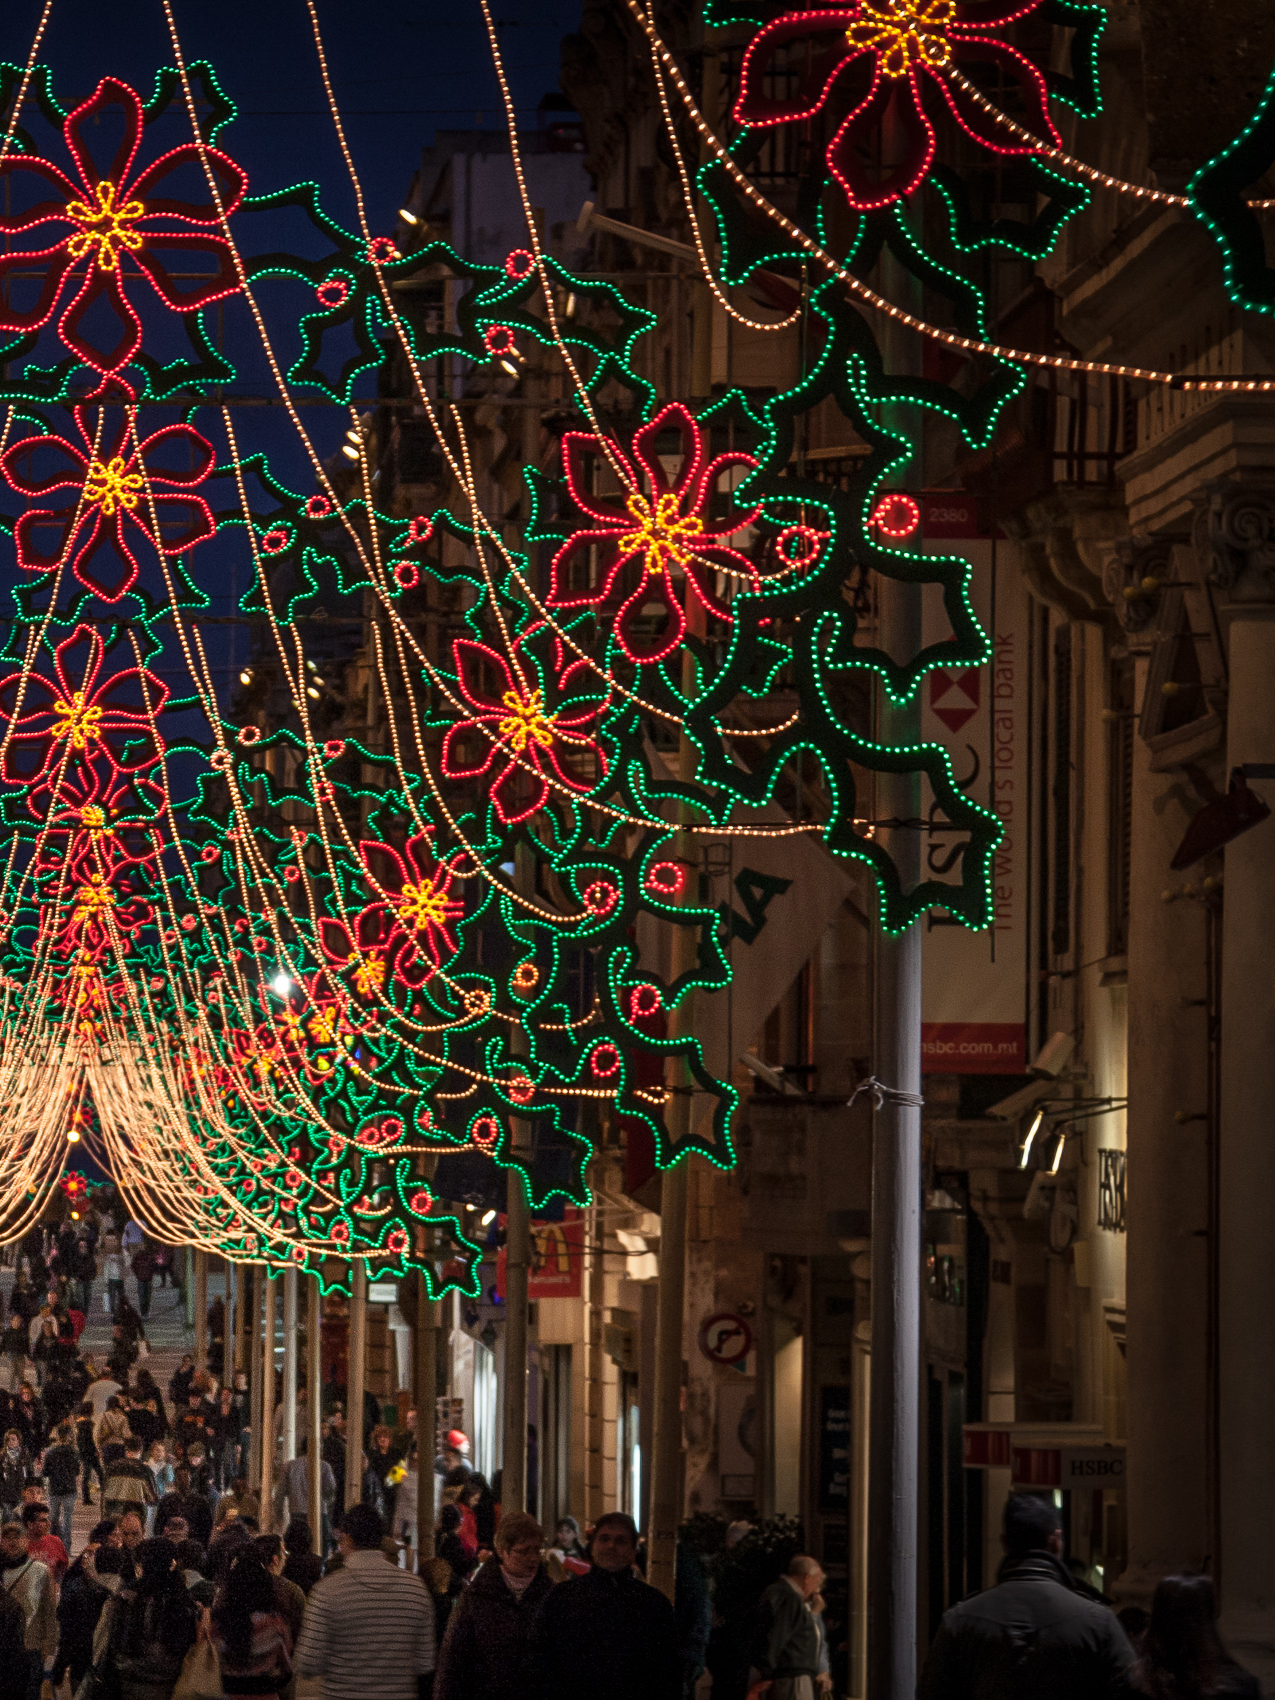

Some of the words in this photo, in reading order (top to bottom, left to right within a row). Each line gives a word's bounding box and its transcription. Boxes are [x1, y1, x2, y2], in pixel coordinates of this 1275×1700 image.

[989, 633, 1014, 699] bank
[989, 709, 1014, 770] local
[1071, 1459, 1123, 1476] HSBC
